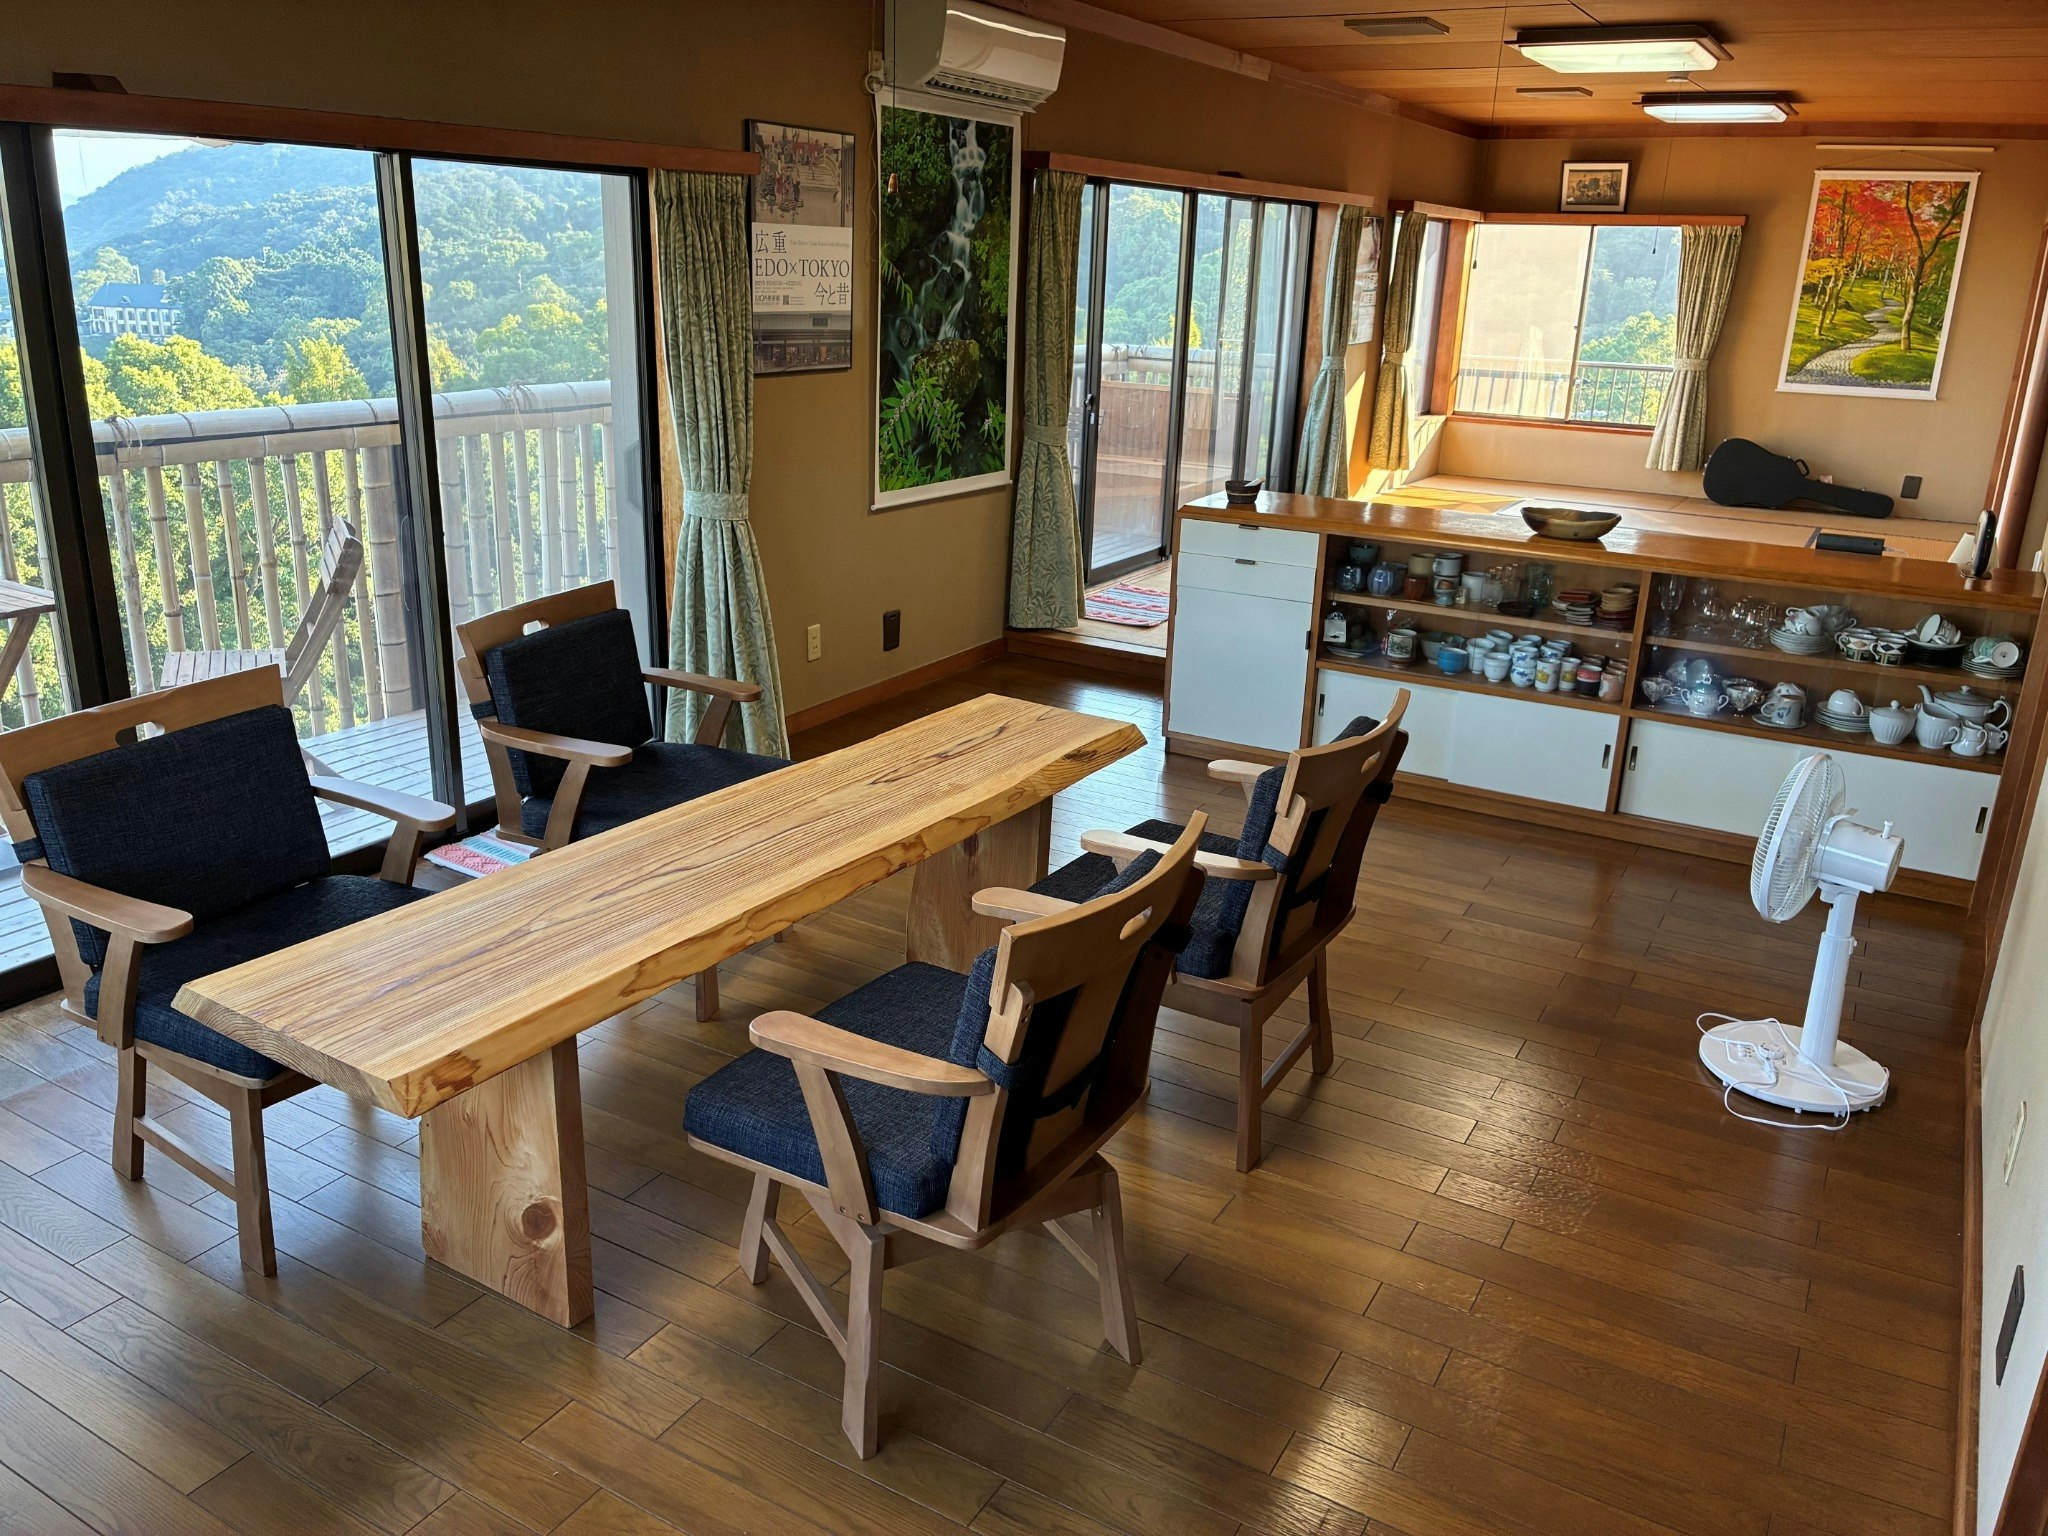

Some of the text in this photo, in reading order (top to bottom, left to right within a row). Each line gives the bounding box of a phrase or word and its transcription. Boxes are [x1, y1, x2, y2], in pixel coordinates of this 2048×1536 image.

[754, 229, 787, 254] 広重
[813, 281, 850, 306] 今と昔
